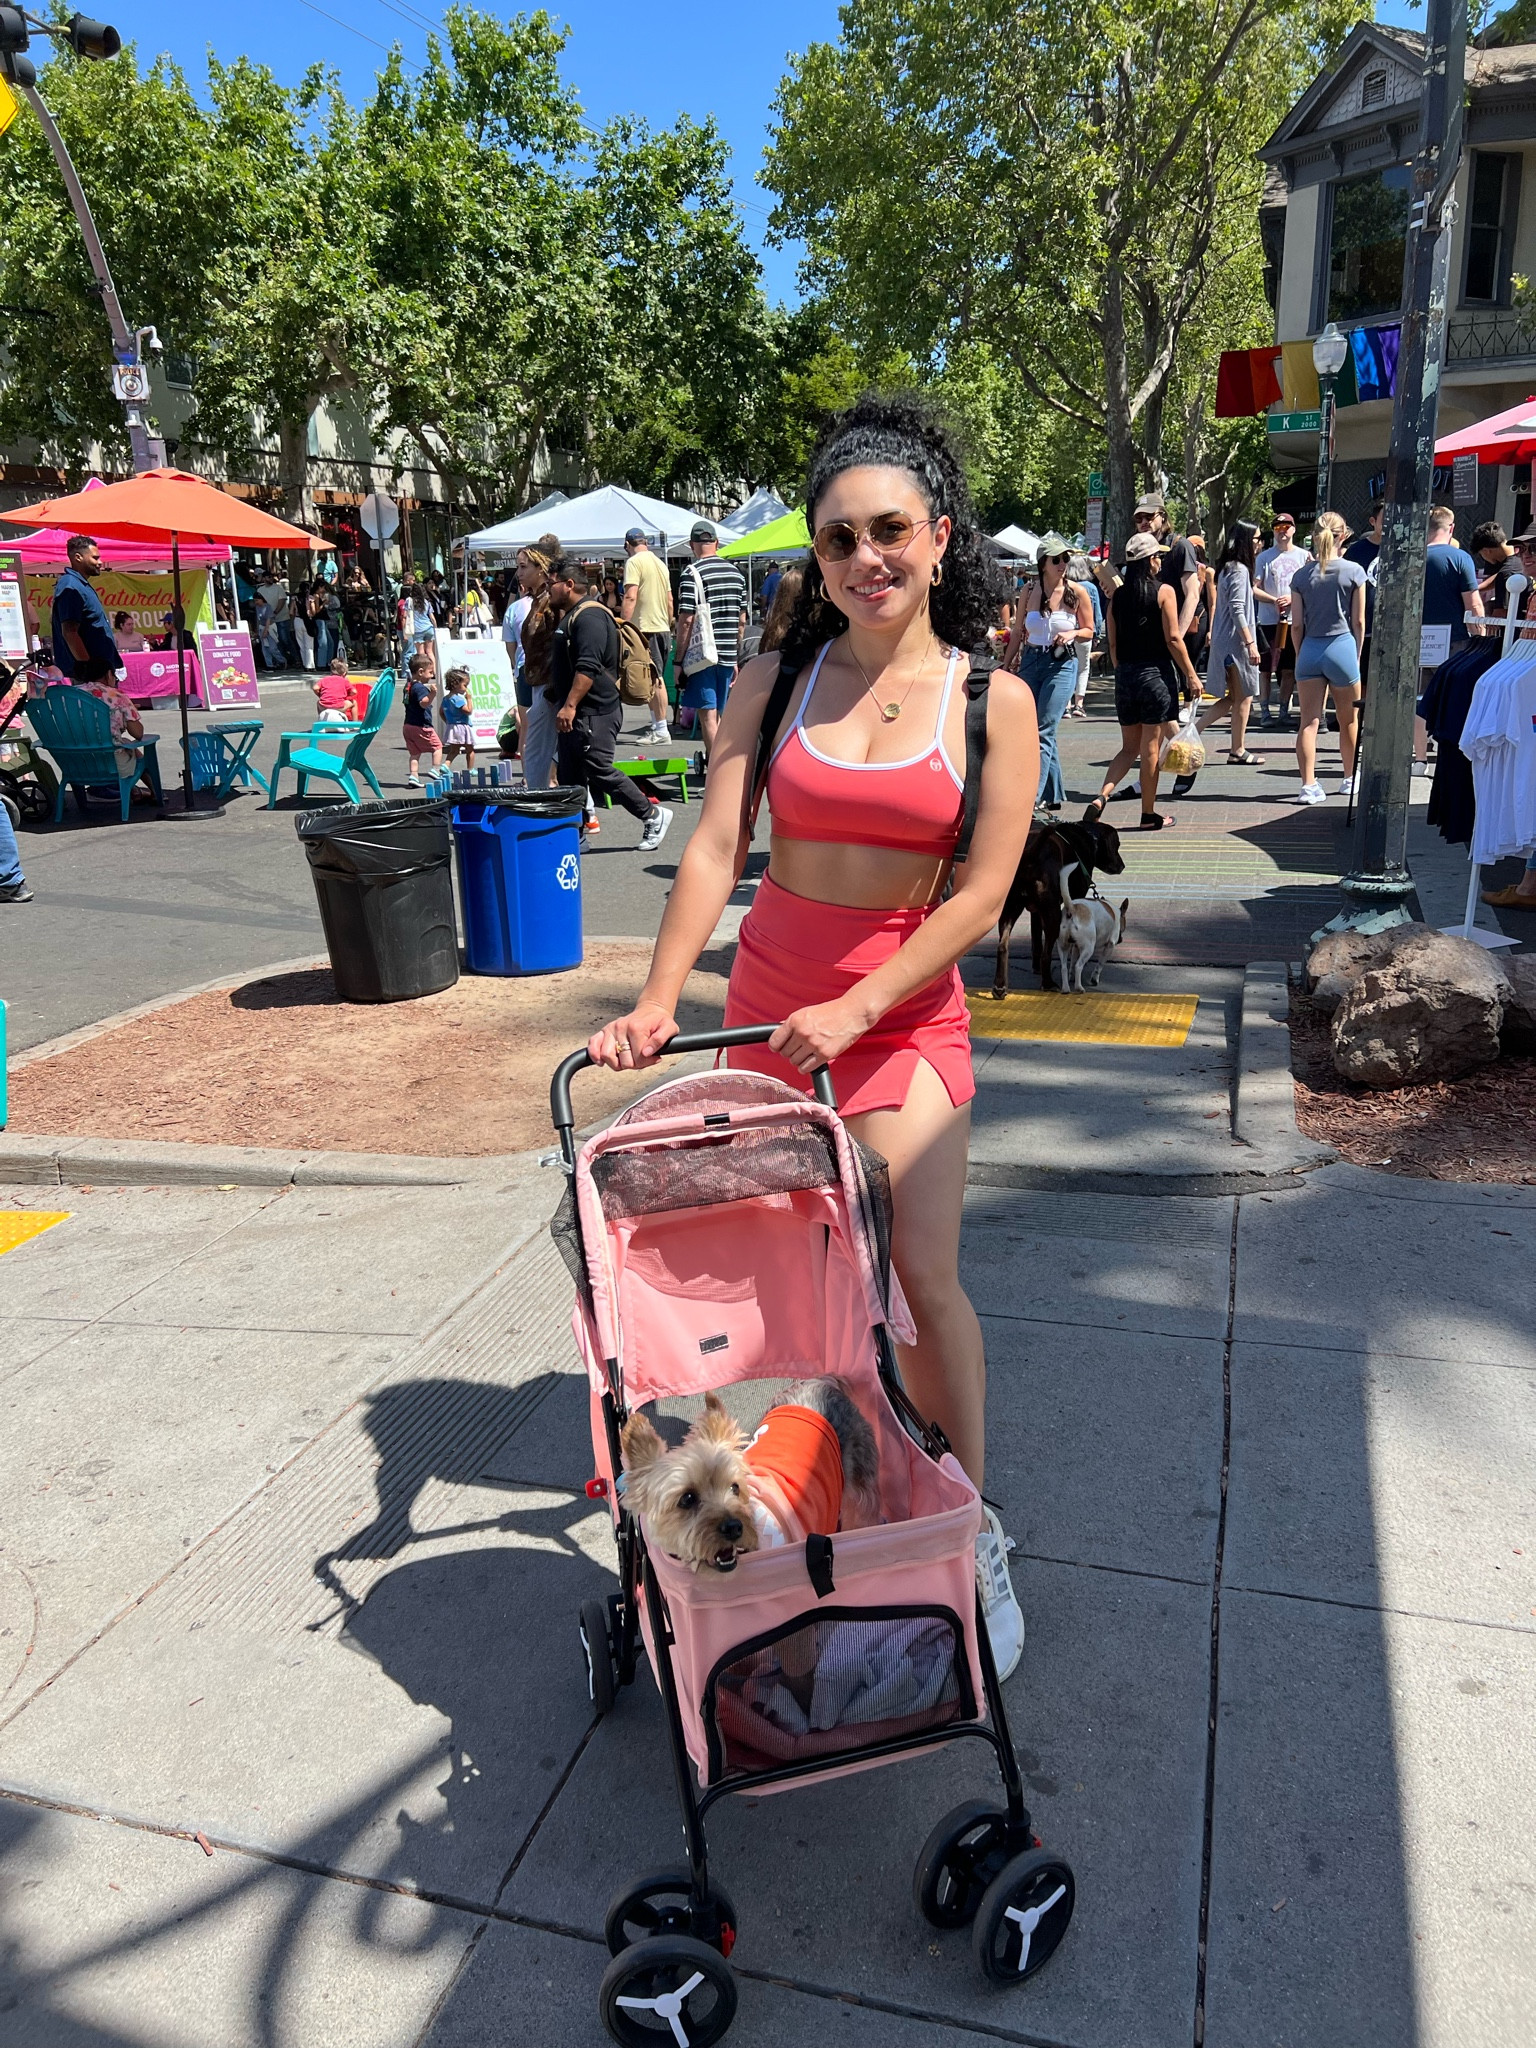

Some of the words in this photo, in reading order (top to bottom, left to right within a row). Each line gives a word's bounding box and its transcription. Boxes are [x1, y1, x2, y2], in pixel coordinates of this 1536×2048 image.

[1282, 416, 1290, 429] K
[230, 650, 242, 658] FOOD
[467, 673, 502, 696] IDS
